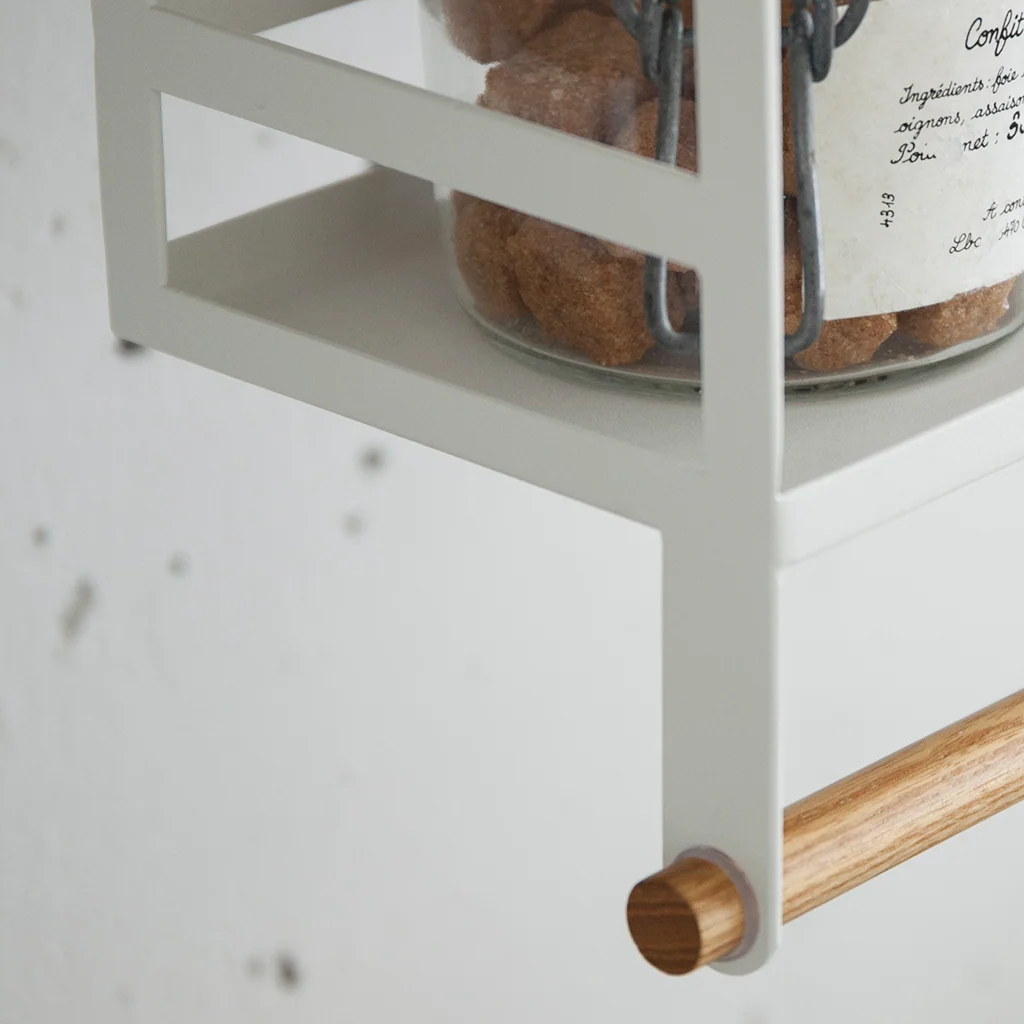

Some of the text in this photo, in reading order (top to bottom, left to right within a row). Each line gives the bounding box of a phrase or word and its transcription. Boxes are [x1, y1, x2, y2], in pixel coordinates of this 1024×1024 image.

[964, 8, 1024, 57] Confit
[990, 65, 1019, 94] foie
[893, 111, 965, 140] oignons,
[880, 192, 895, 228] 4313
